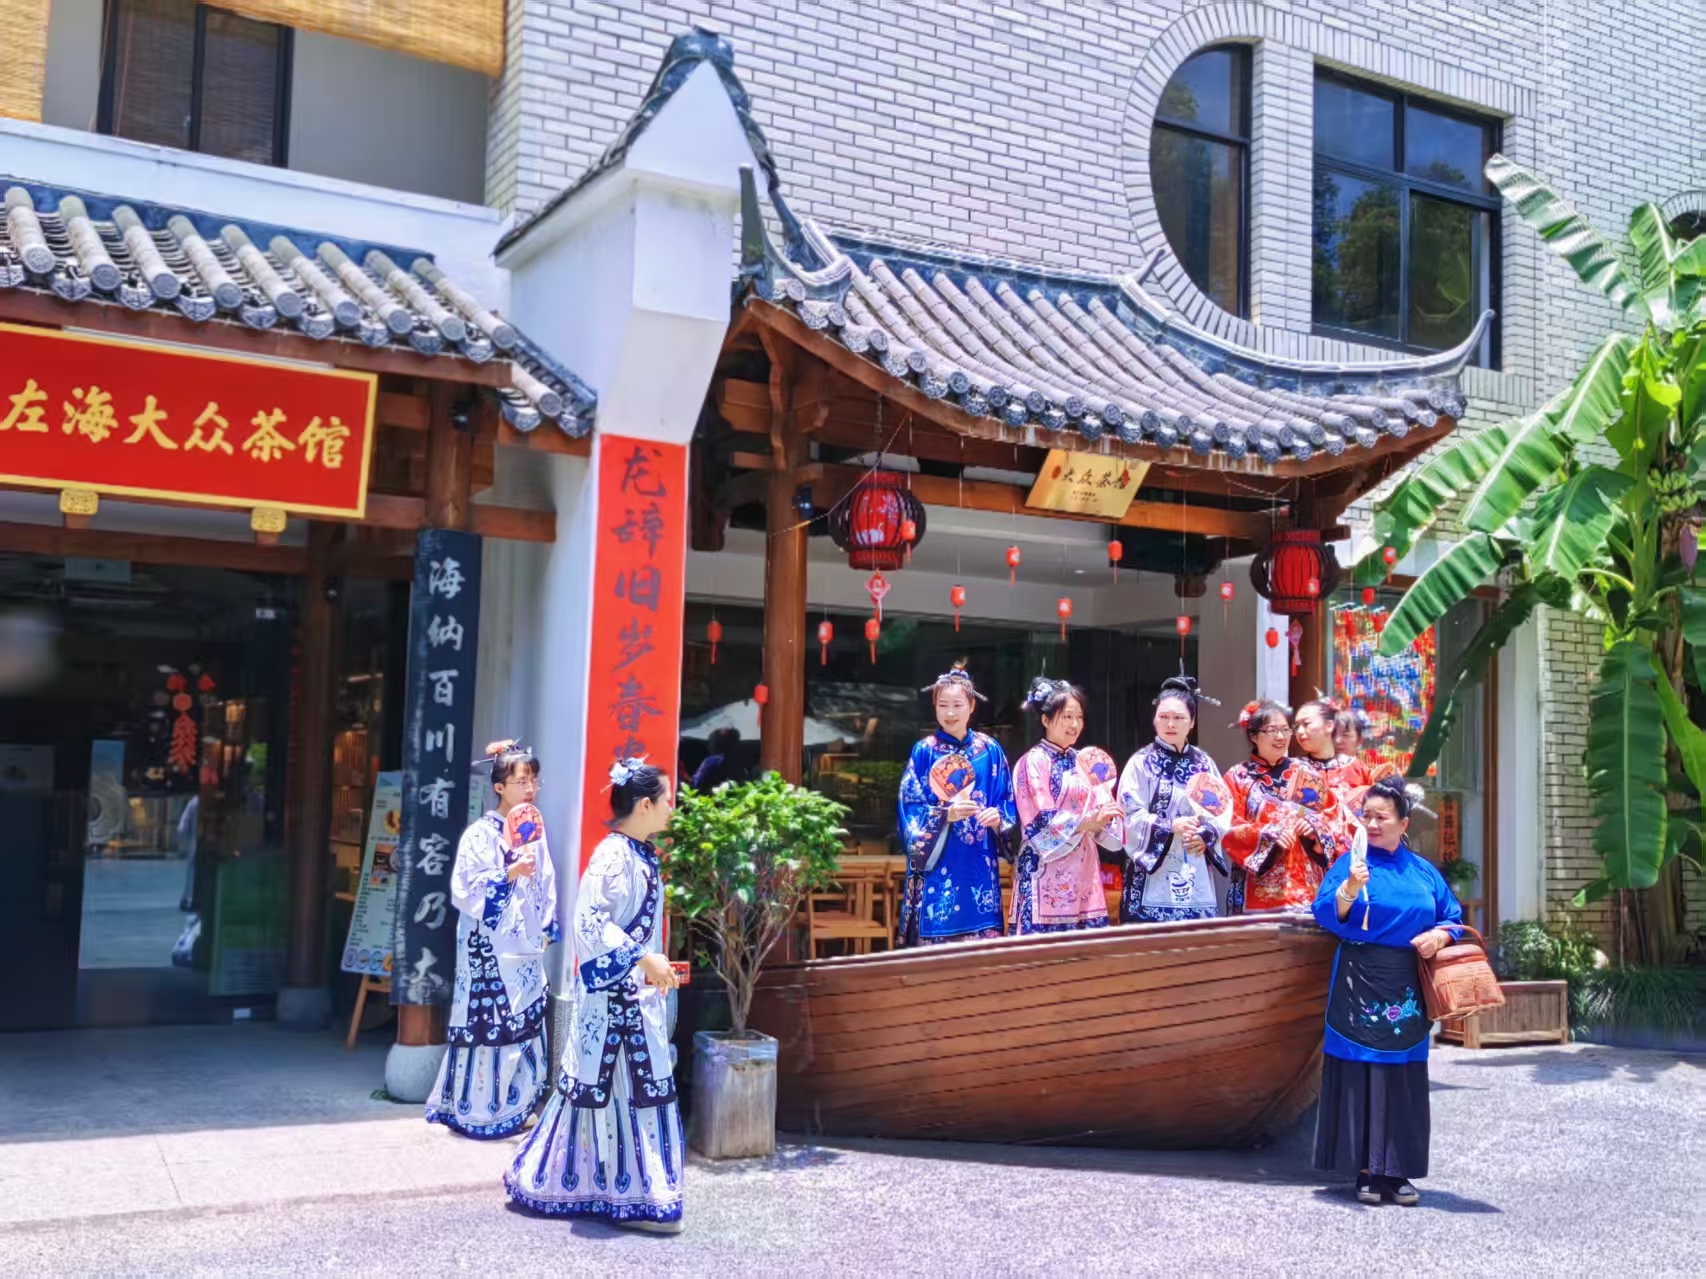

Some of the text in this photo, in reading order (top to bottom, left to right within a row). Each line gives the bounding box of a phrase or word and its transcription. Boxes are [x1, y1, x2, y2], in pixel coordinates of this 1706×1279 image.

[0, 378, 351, 469] 左海大众茶馆
[409, 557, 465, 987] 海纳百川有容乃大
[608, 444, 667, 832] 龙辞旧岁春
